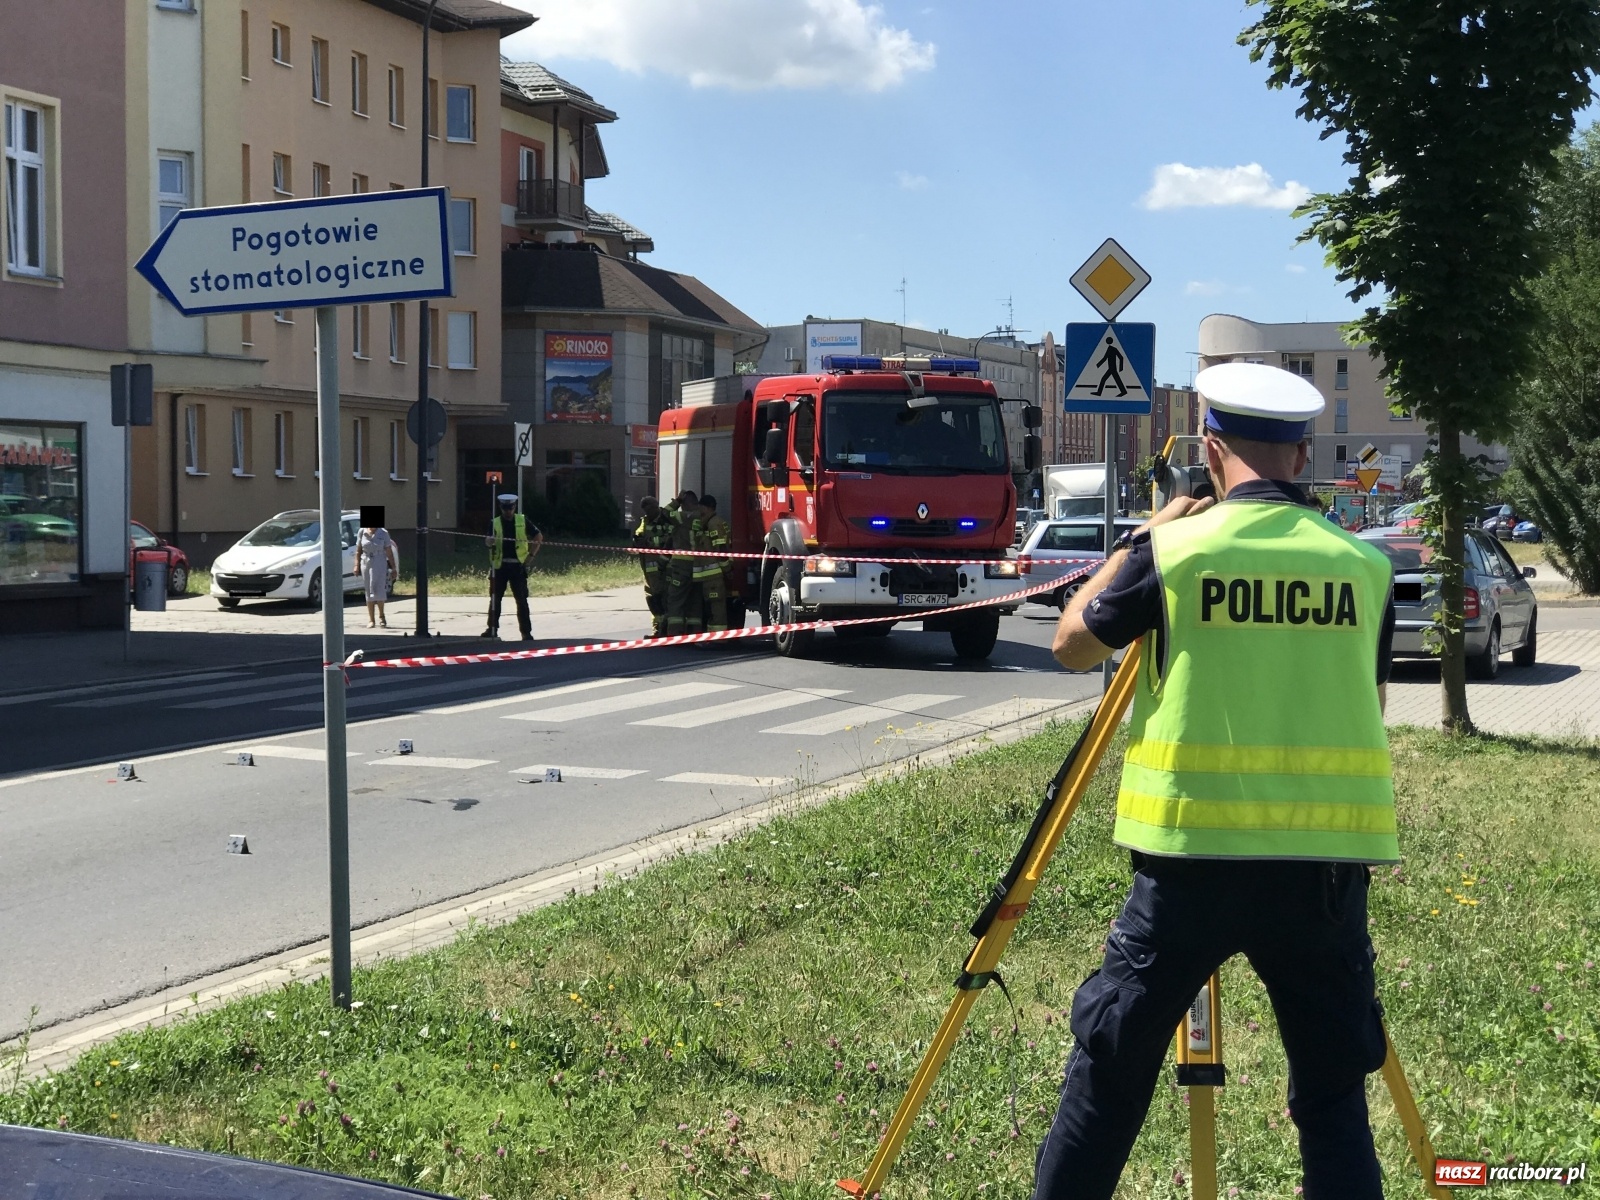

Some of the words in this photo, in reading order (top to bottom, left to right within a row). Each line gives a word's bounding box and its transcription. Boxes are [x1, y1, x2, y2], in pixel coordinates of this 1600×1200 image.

[232, 217, 379, 256] Pogotowie
[190, 256, 425, 294] stomatologiczne
[553, 339, 609, 355] ORINOKO
[904, 594, 923, 604] SRC
[1201, 578, 1357, 626] POLICJA
